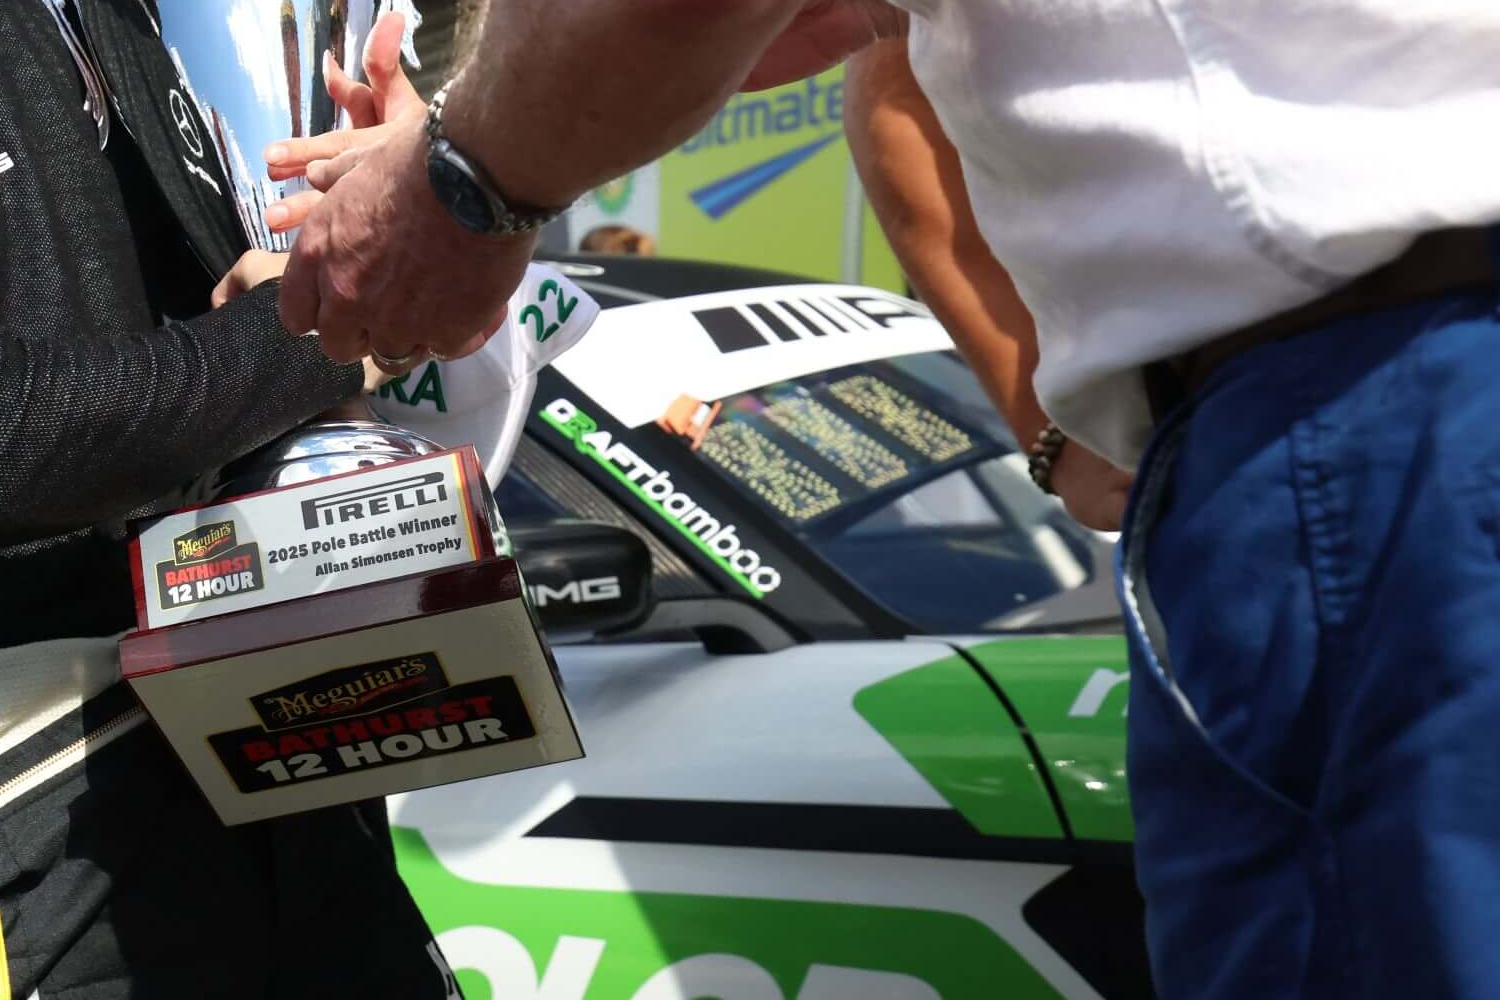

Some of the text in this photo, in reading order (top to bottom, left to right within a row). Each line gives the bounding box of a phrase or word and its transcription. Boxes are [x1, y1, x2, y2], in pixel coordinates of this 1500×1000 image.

[519, 279, 578, 342] 22
[301, 471, 448, 530] PIRELLI
[543, 398, 782, 593] DRAFTbamboo
[268, 514, 457, 564] 2025 Pole Battle Winner
[315, 536, 463, 577] Allan Simonsen Trophy
[165, 555, 252, 586] BATHURST
[168, 571, 255, 604] 12 HOUR
[529, 576, 621, 607] MG
[272, 657, 428, 723] Meguiar's
[243, 696, 493, 761] BATHURST
[255, 717, 509, 782] 12 HOUR
